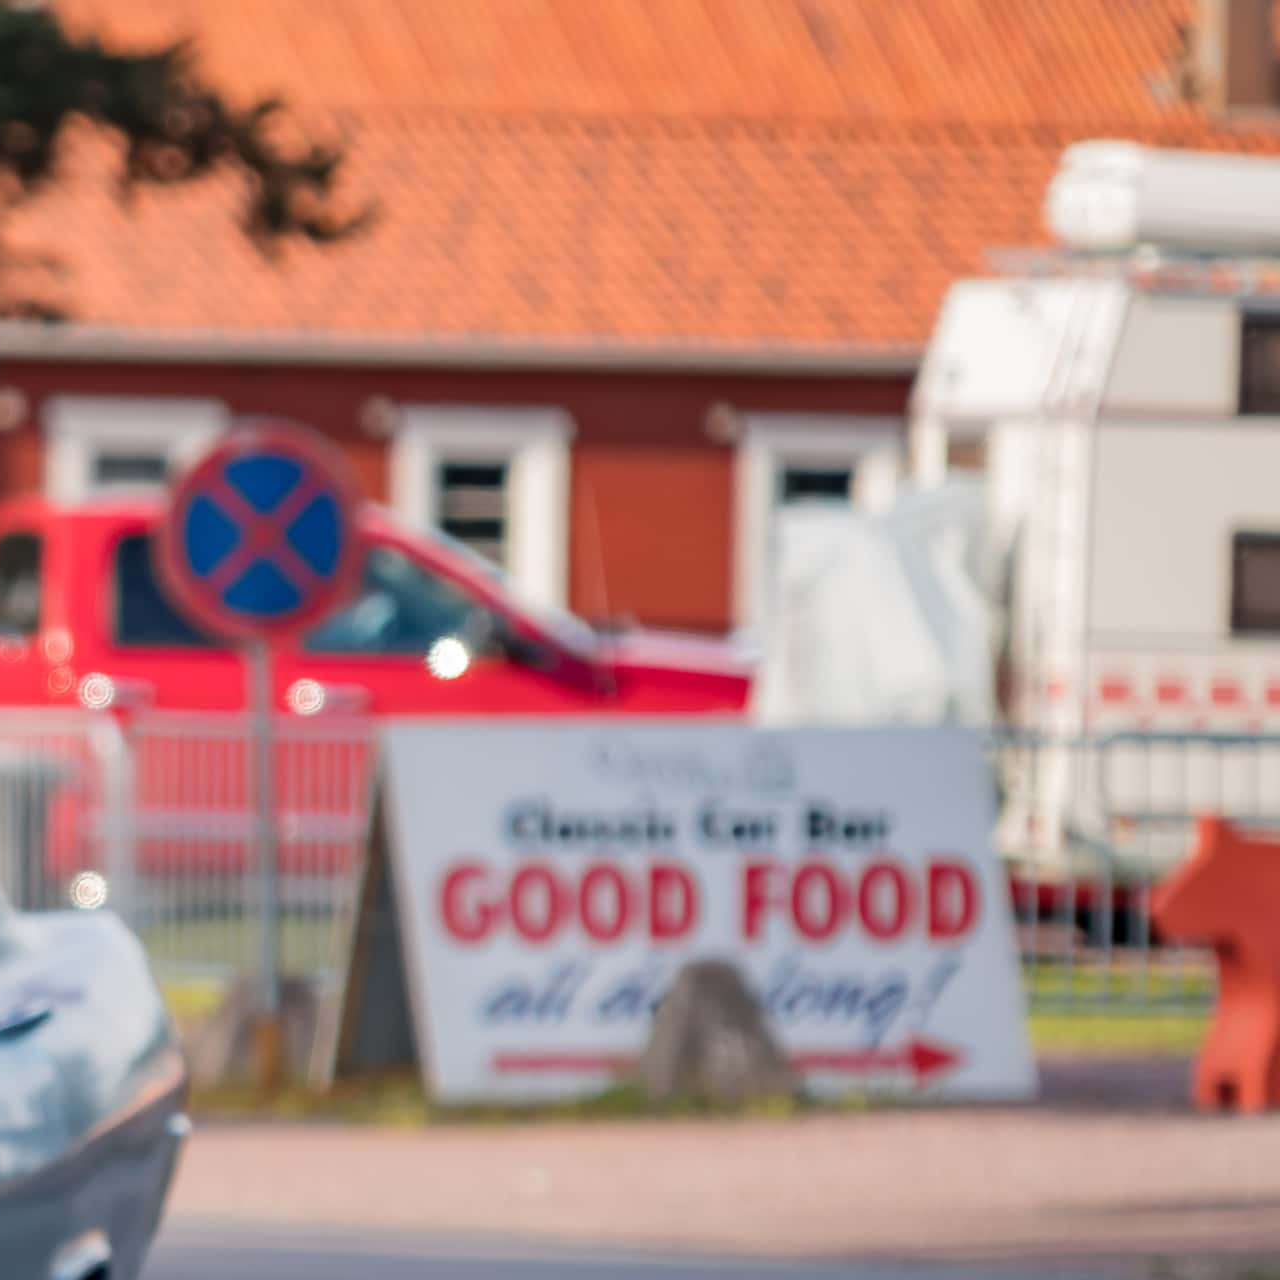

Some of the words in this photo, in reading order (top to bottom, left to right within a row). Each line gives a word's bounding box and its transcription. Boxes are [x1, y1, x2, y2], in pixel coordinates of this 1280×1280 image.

[508, 802, 676, 843] Classic
[699, 803, 777, 845] Car
[805, 804, 889, 844] Bar
[438, 859, 701, 947] GOOD
[739, 859, 981, 947] FOOD
[483, 955, 592, 1023] all
